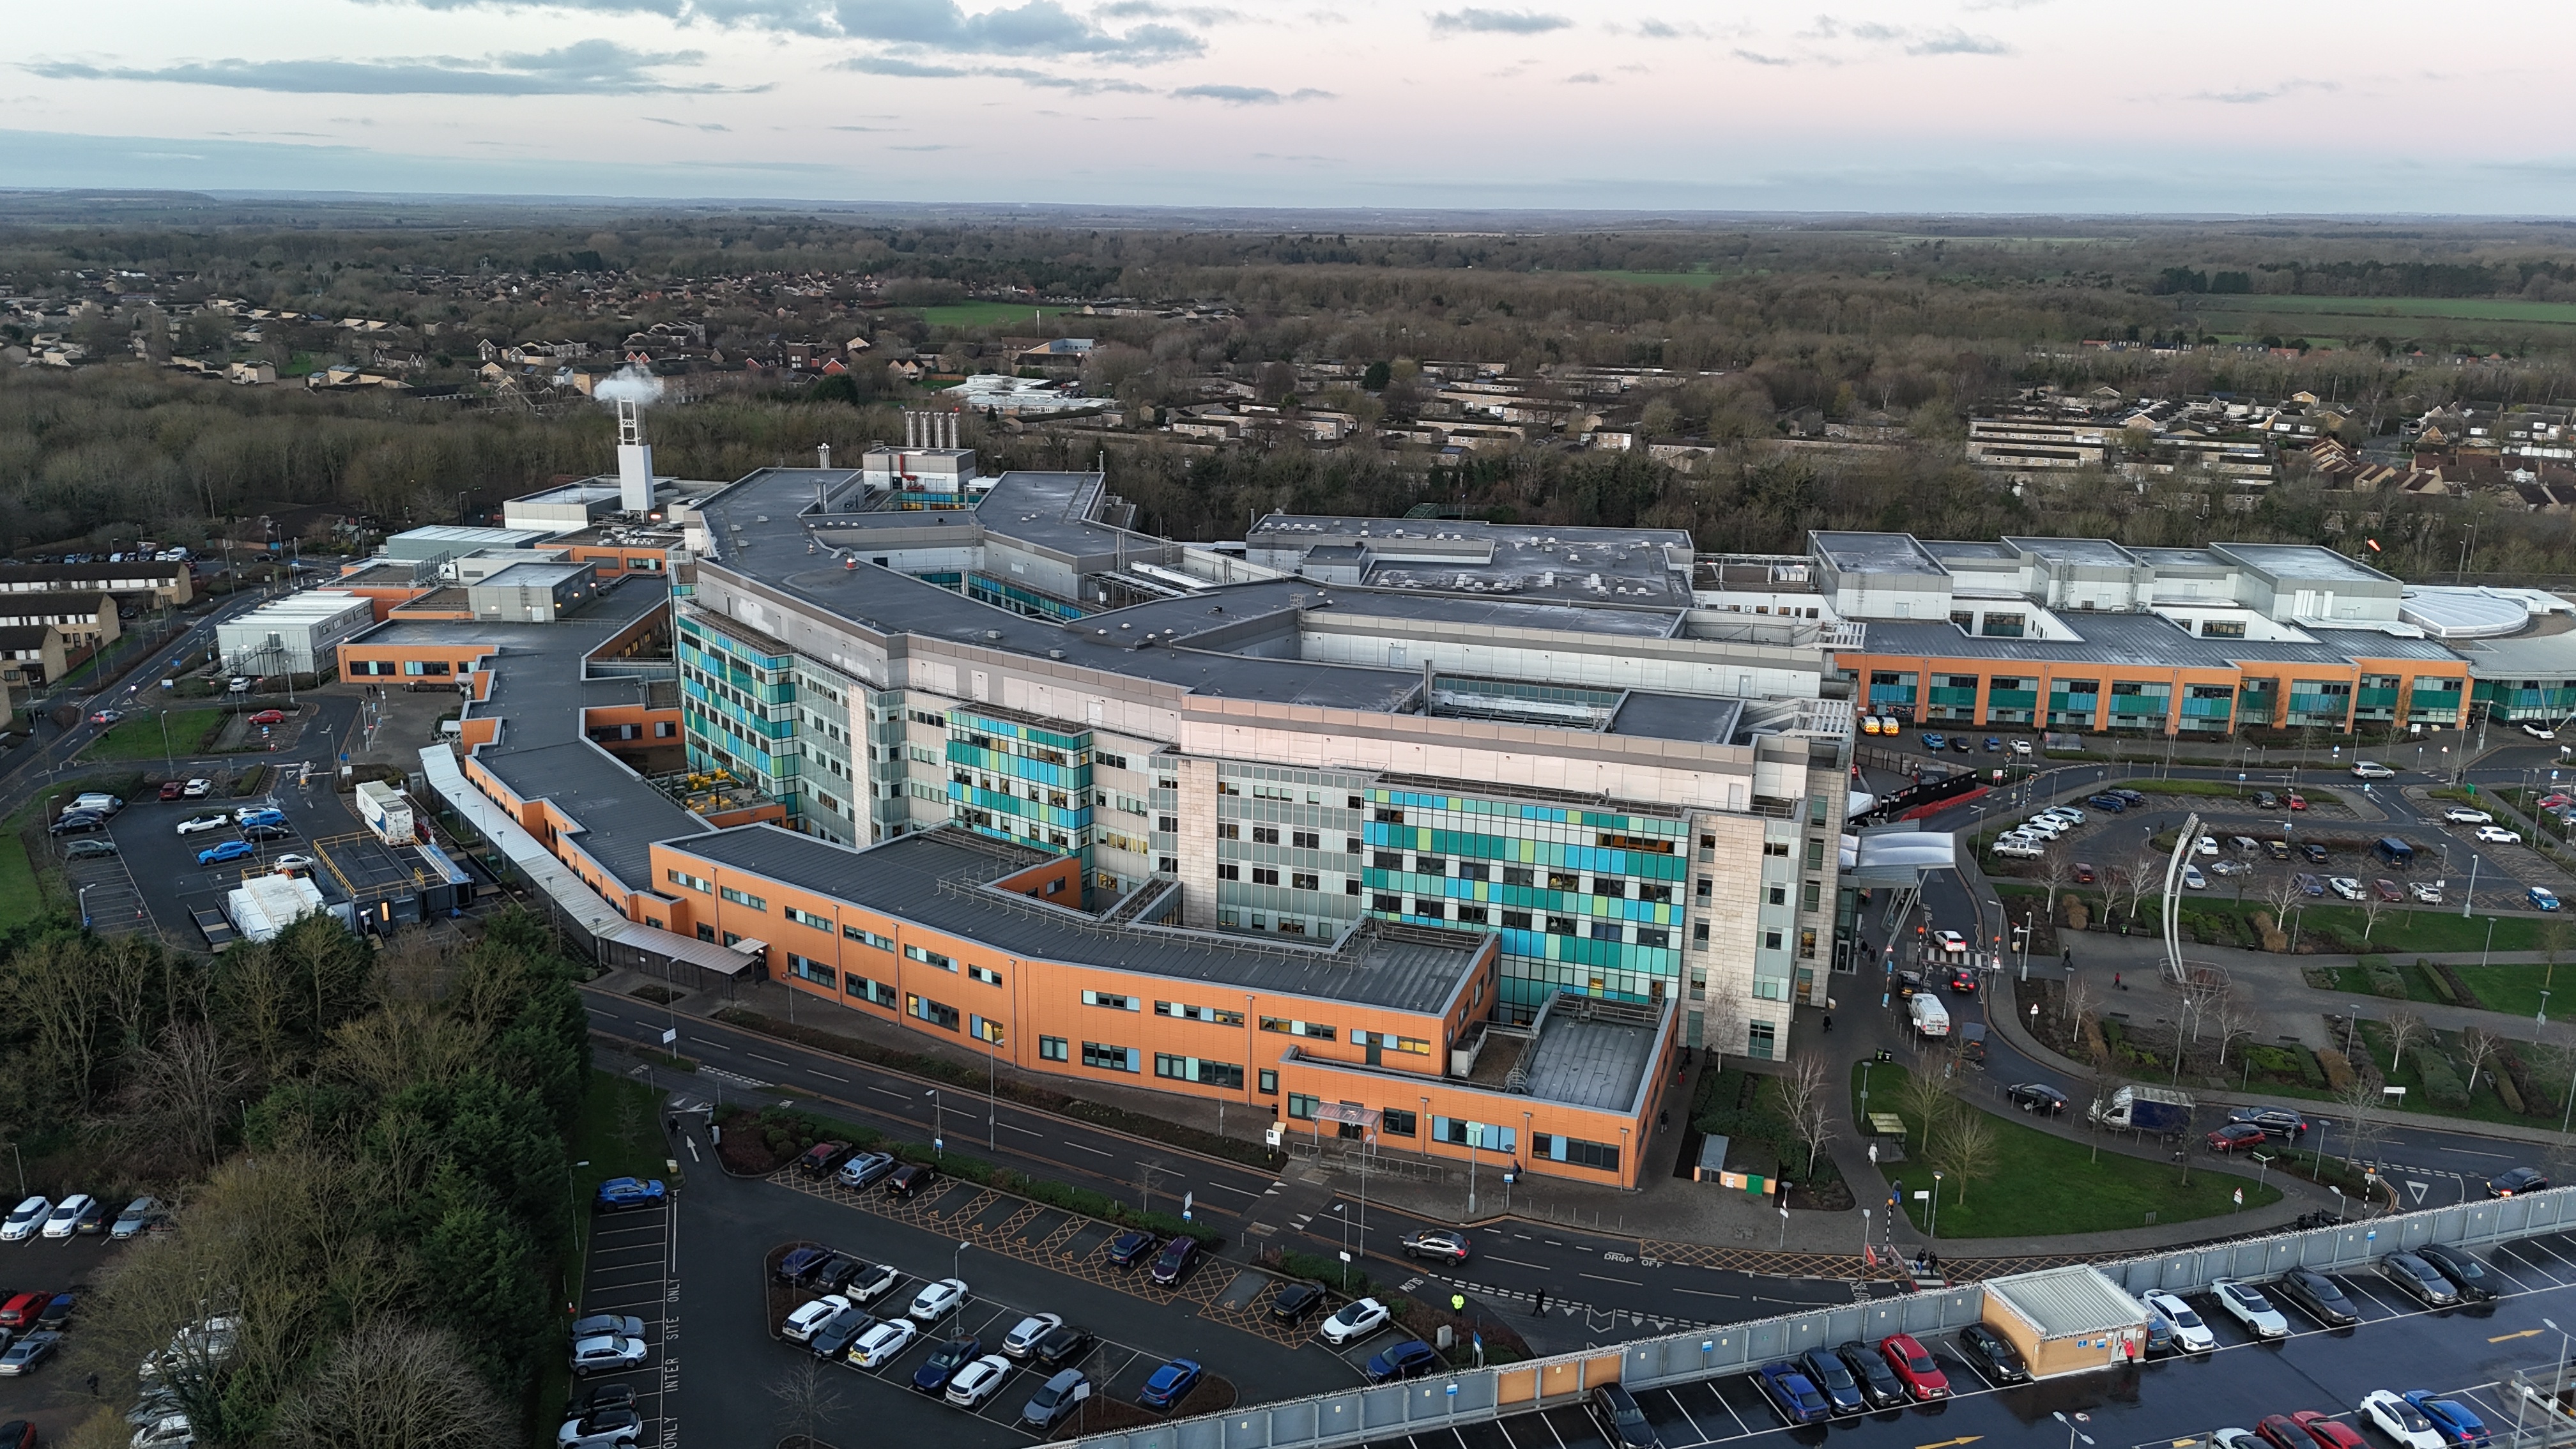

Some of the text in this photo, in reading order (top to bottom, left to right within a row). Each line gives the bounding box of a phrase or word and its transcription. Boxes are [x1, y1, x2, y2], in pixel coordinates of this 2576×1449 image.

[1604, 1253, 1665, 1268] DROP OFF
[1399, 1277, 1424, 1293] SLOW
[663, 1278, 680, 1449] ONLY INTER SITE ONLY
